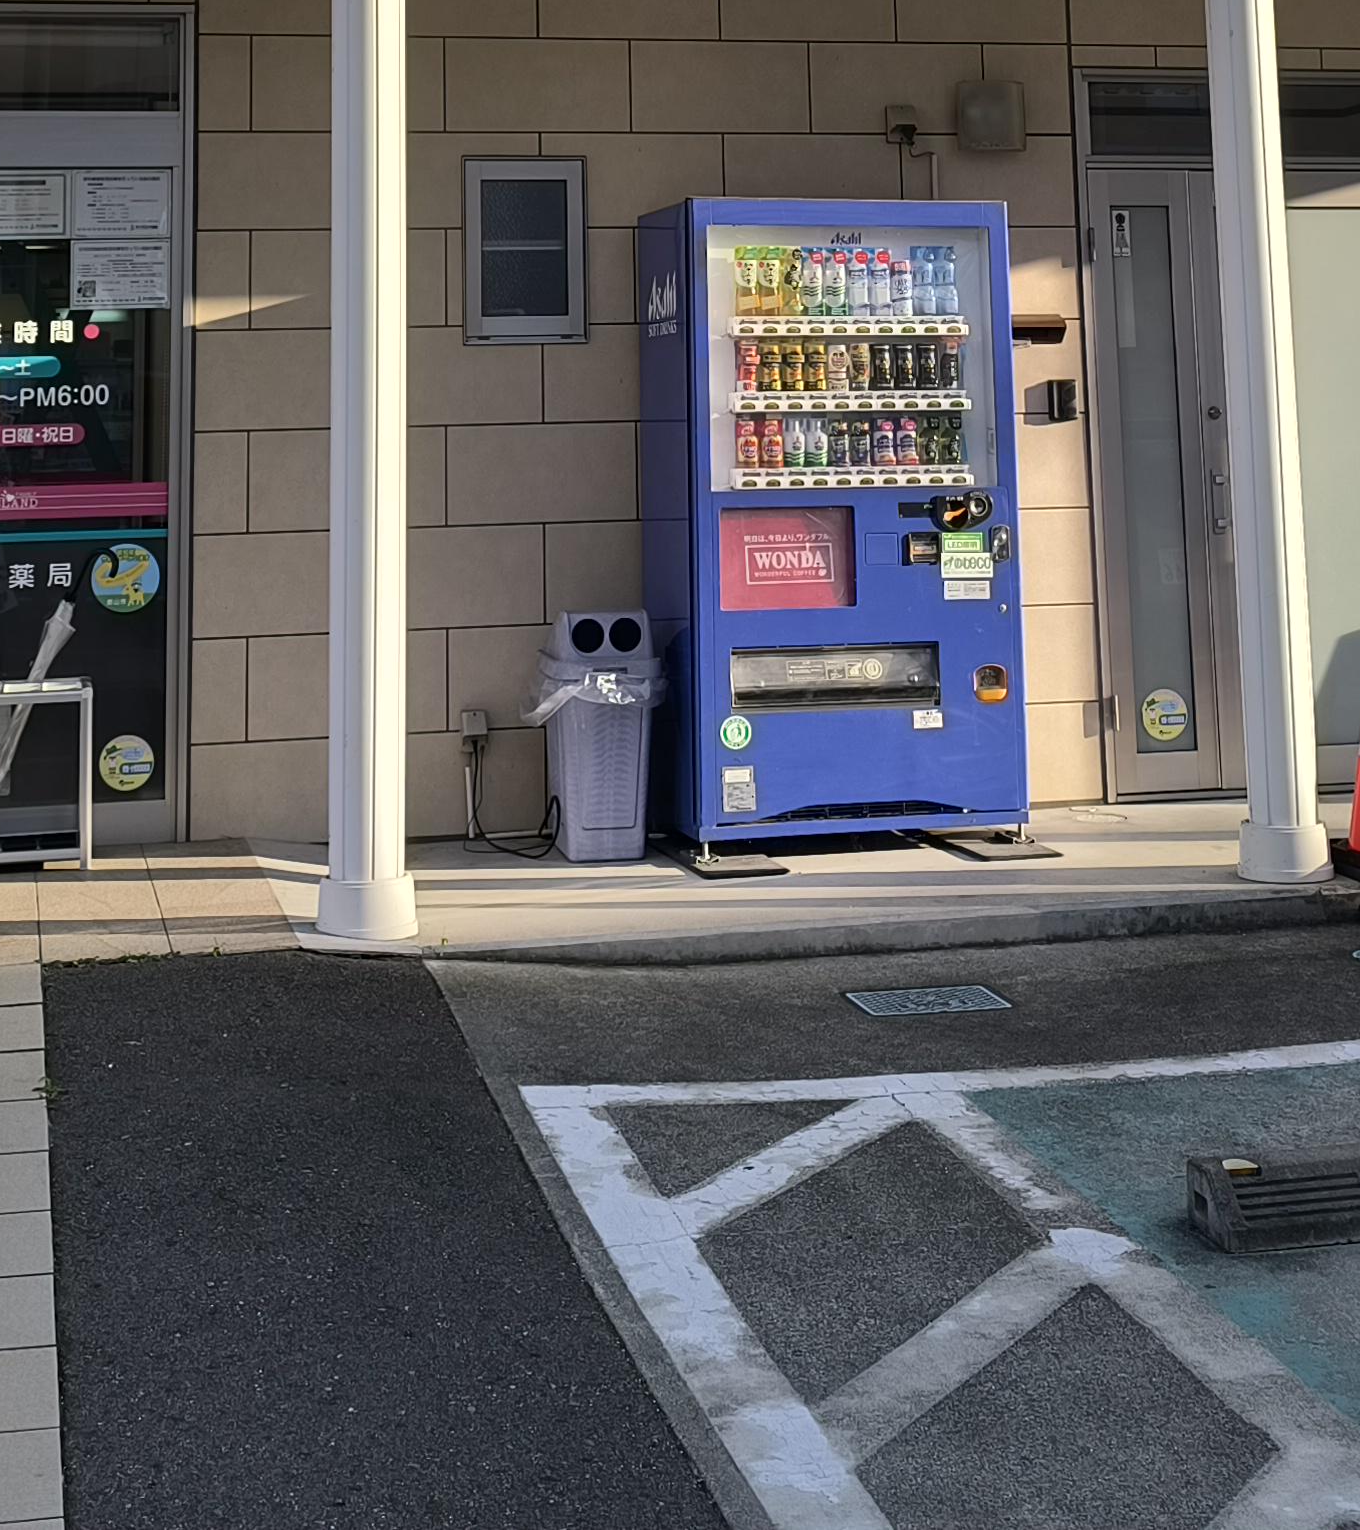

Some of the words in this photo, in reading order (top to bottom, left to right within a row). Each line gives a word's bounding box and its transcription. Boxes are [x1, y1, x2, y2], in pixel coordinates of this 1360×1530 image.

[831, 232, 861, 245] Asahi
[649, 270, 677, 321] Asahi
[754, 550, 827, 570] WONDA
